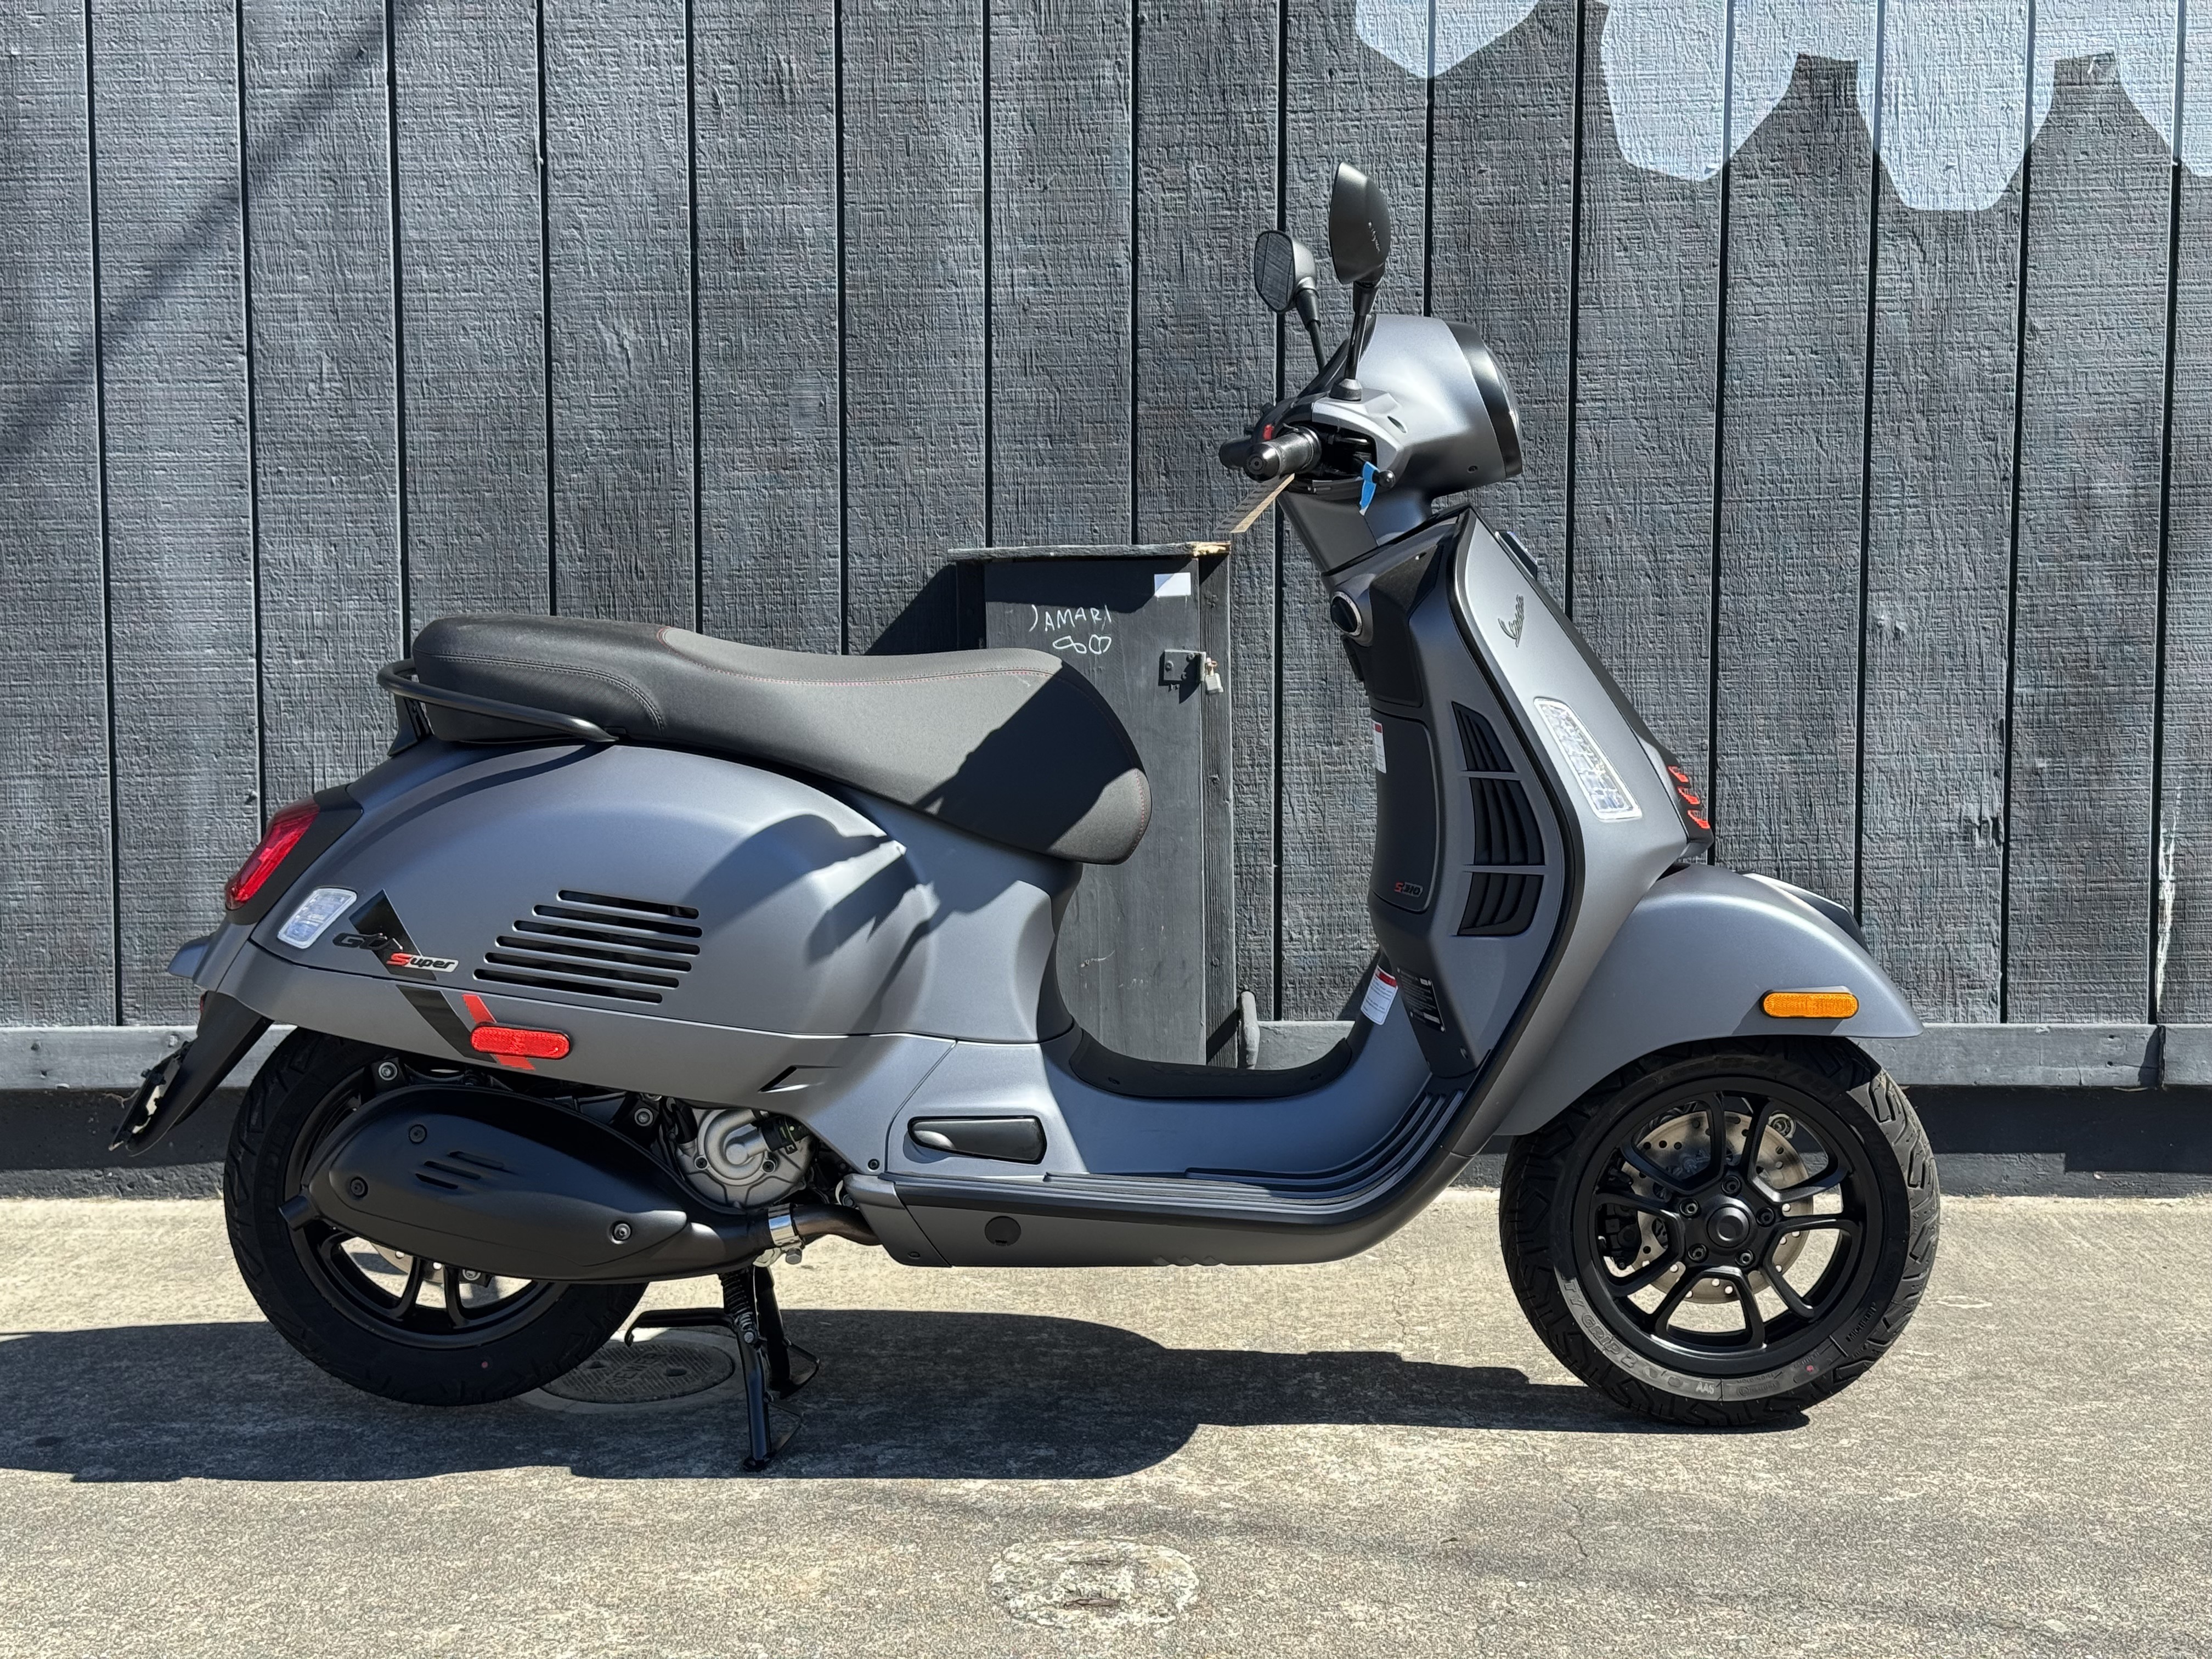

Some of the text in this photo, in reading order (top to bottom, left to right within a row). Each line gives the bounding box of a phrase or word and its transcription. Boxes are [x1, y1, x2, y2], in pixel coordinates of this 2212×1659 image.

[1029, 604, 1112, 632] JAMARI
[386, 952, 456, 969] Super
[1581, 1313, 1622, 1355] GRIP
